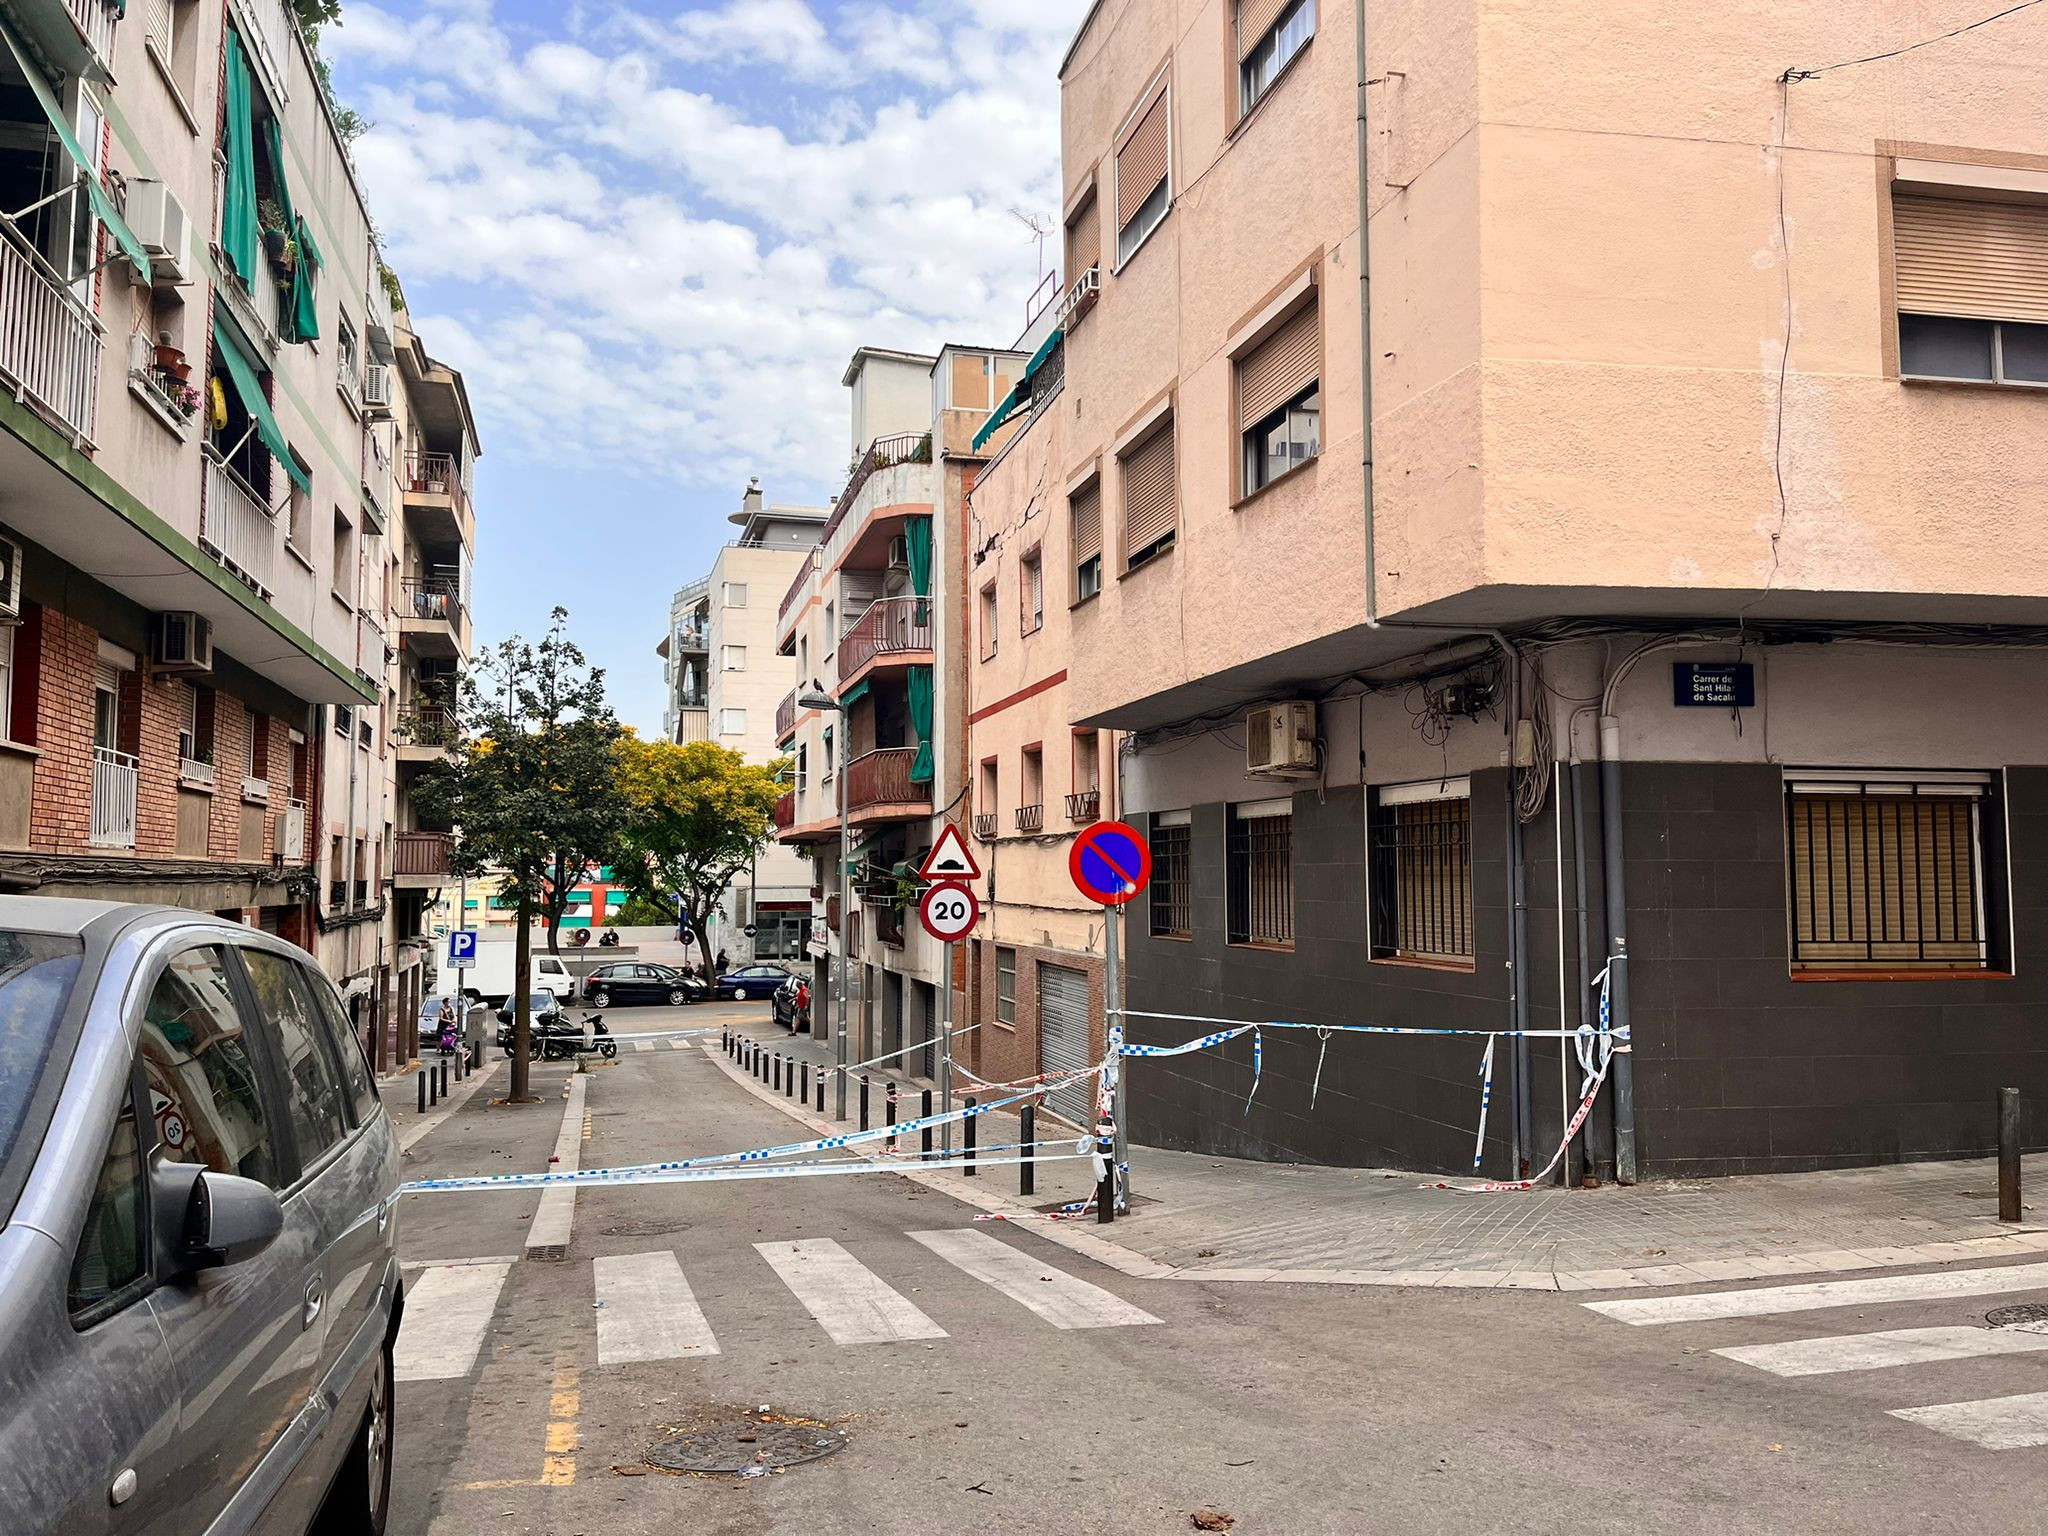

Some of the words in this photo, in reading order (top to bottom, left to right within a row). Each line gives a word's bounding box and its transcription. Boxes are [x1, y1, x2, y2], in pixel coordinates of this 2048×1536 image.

[1693, 674, 1719, 683] Carrer
[1721, 675, 1732, 683] de
[1693, 683, 1712, 692] Sant
[1693, 693, 1704, 701] de
[935, 902, 965, 919] 20
[454, 934, 471, 955] P
